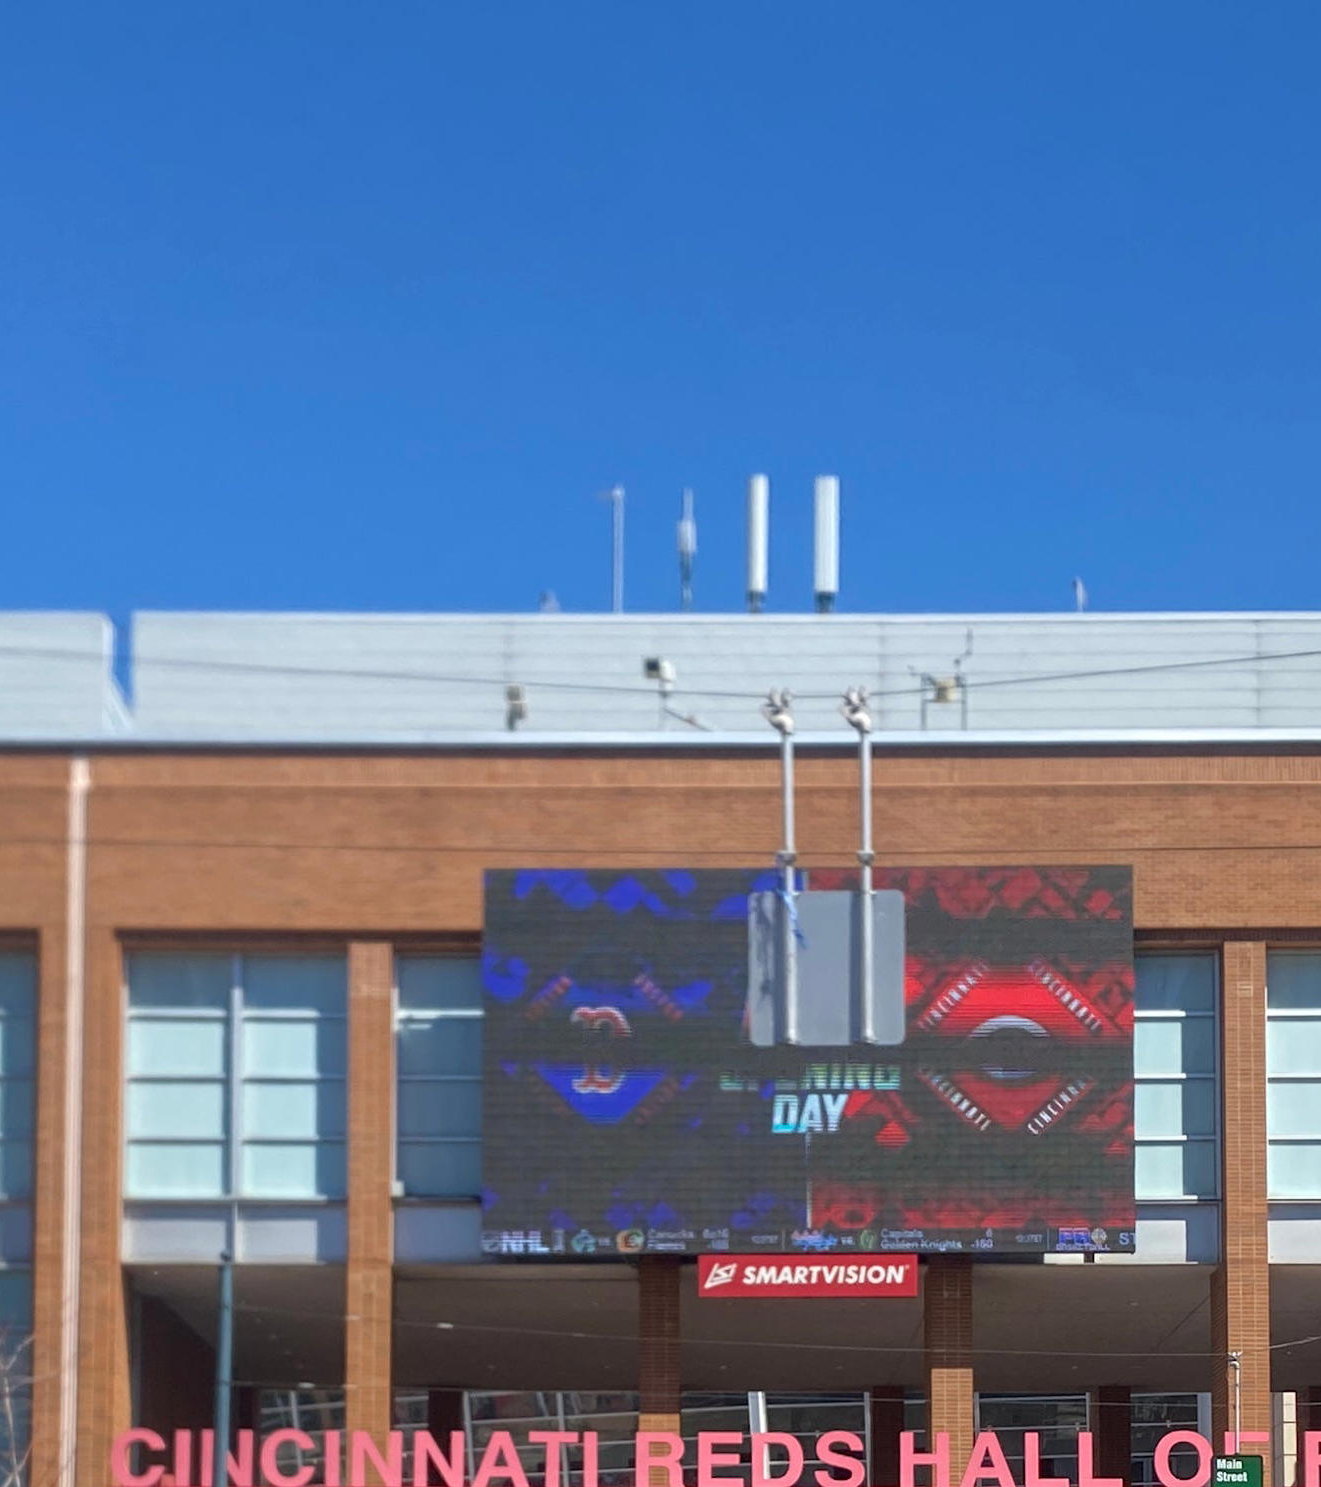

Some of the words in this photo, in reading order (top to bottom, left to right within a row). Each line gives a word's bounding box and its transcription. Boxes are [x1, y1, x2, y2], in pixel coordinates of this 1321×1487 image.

[772, 1093, 849, 1133] DAY
[742, 1264, 906, 1286] SMARTVISION
[1216, 1458, 1243, 1471] Main
[1216, 1471, 1248, 1483] Street
